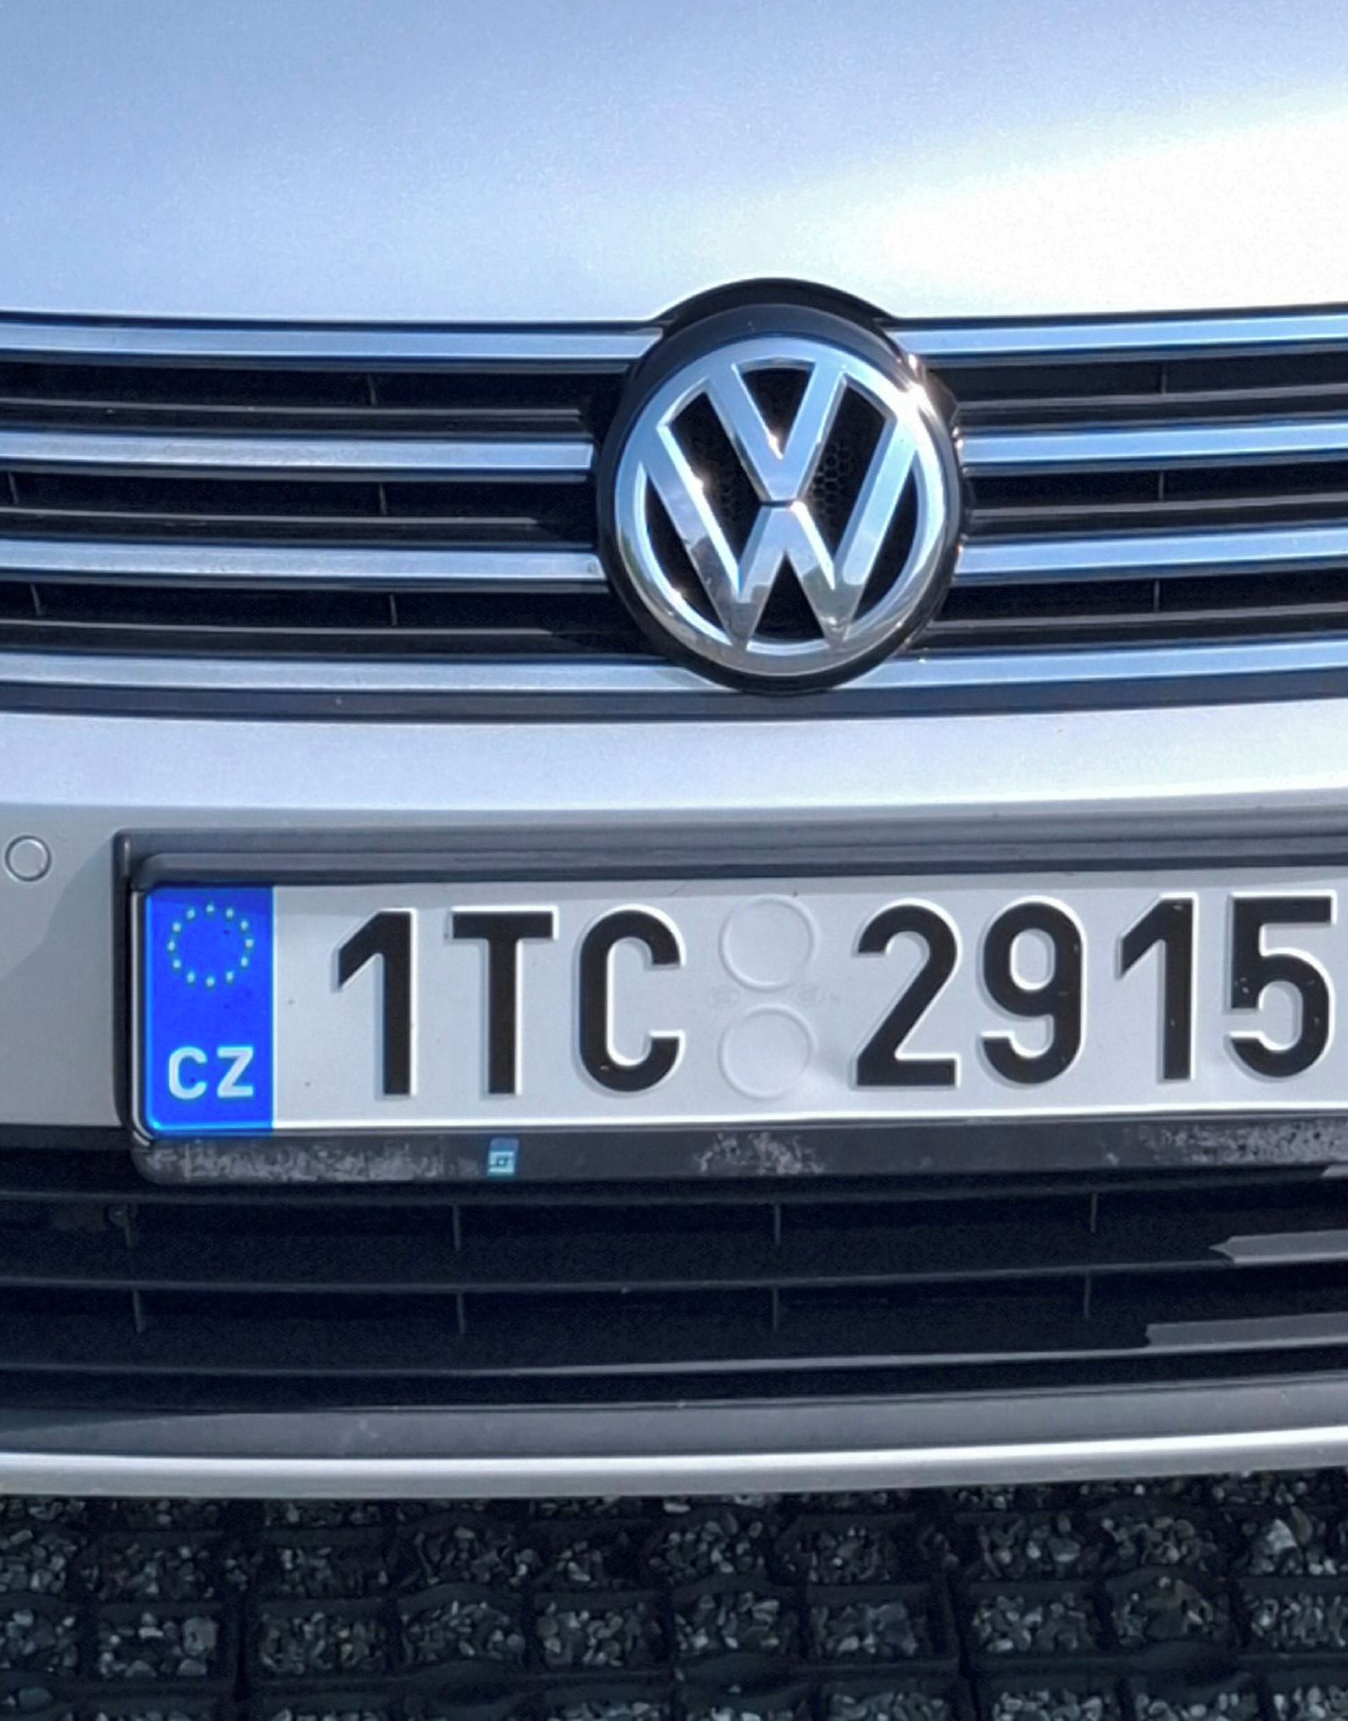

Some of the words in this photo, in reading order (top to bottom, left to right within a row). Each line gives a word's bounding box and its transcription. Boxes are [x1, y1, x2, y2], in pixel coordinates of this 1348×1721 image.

[618, 338, 945, 674] VW
[168, 1045, 255, 1100] CZ
[336, 906, 686, 1098] 1TC
[853, 894, 1336, 1088] 2915
